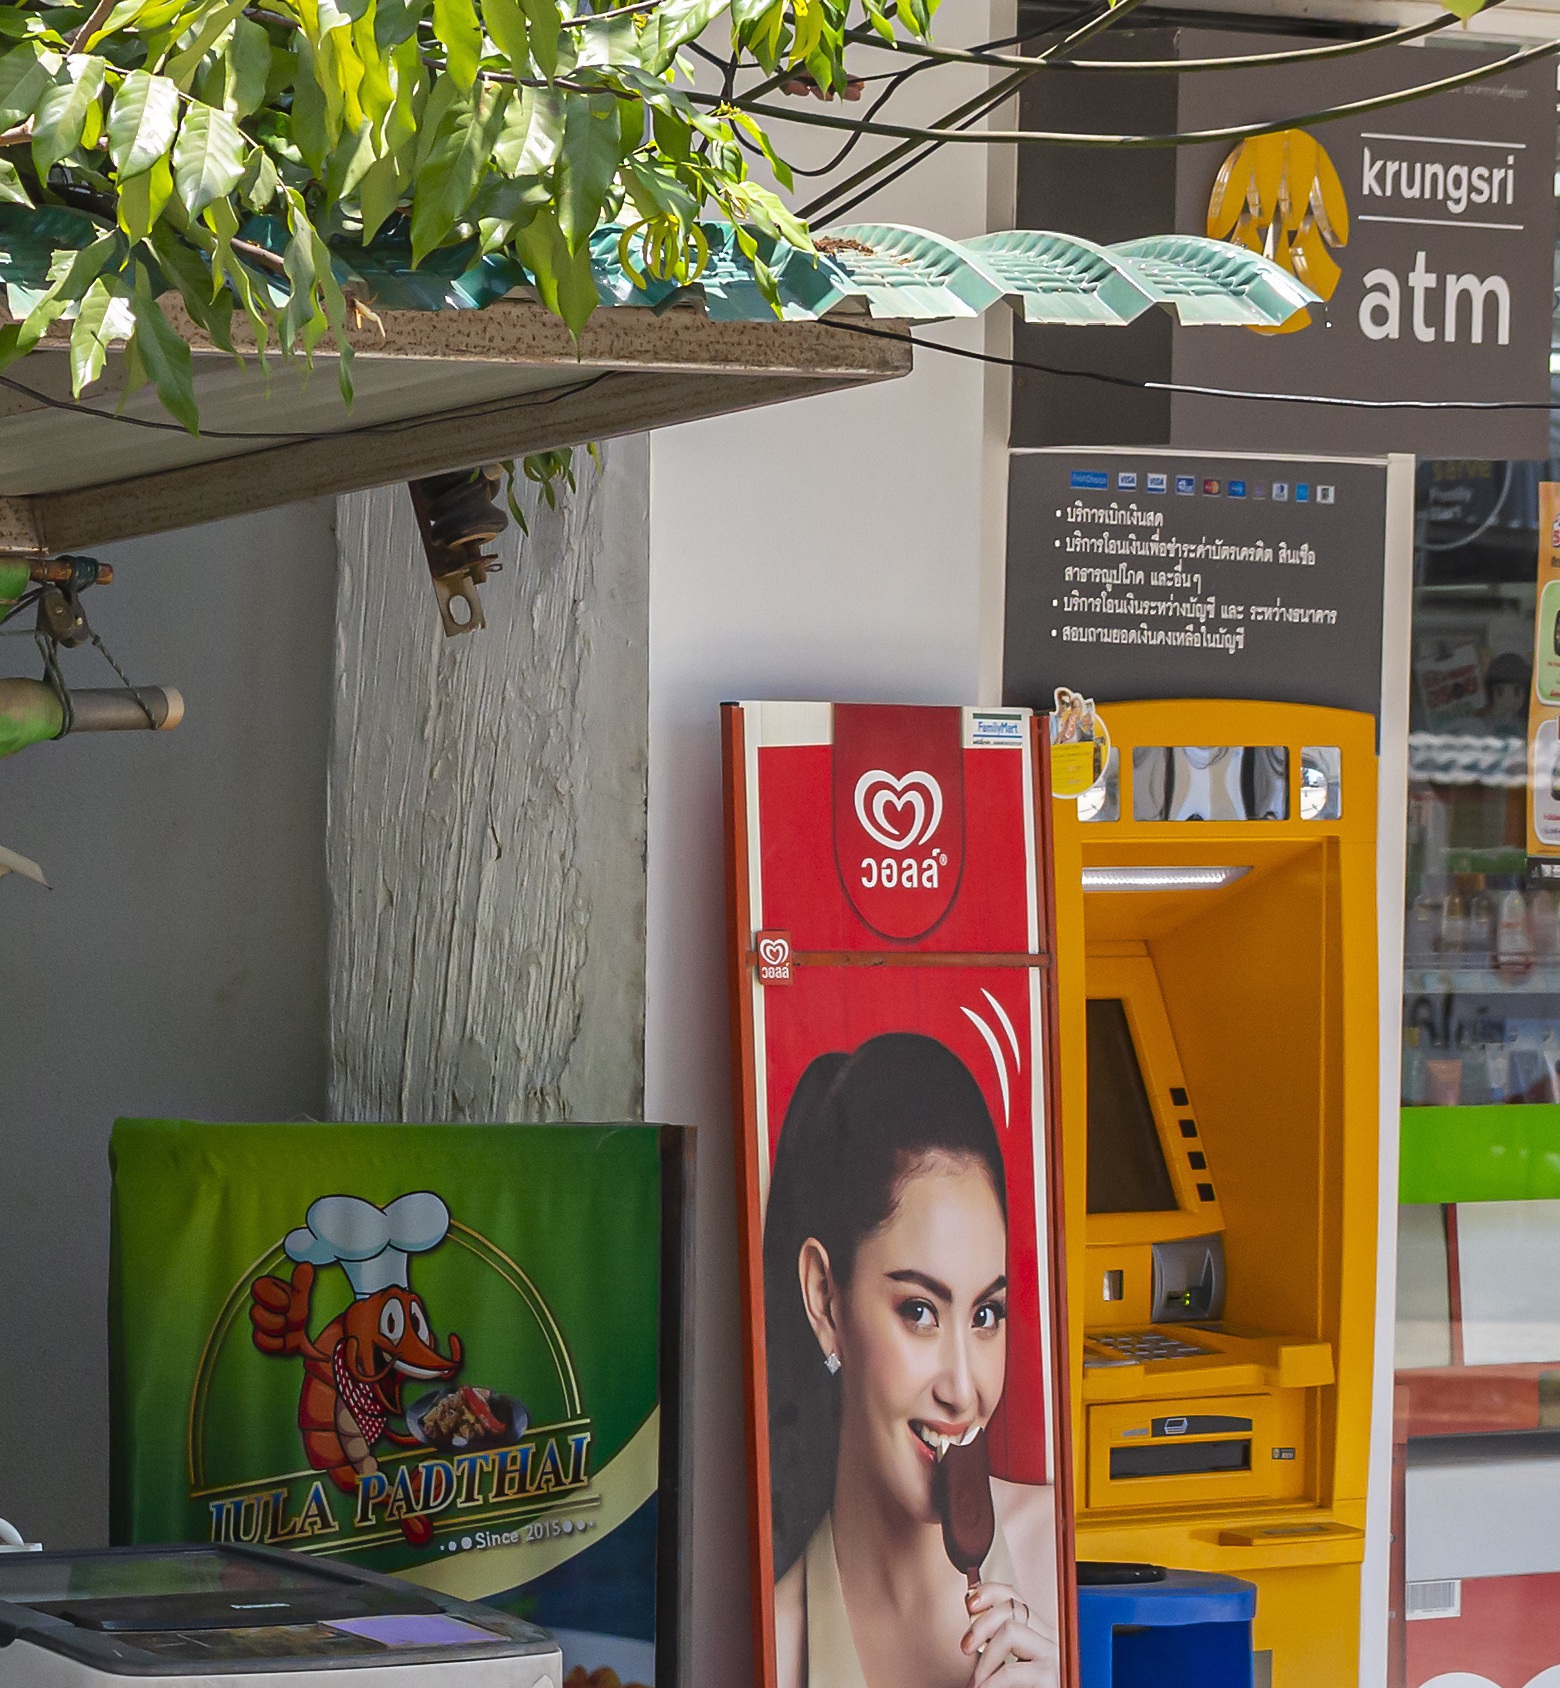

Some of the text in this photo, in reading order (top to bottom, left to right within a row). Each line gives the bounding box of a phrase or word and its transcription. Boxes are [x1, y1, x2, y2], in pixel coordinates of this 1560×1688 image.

[1362, 146, 1515, 214] krungsri
[1358, 250, 1510, 346] atm
[1066, 500, 1164, 527] บริการเบิกเงินสด
[1220, 604, 1244, 620] และ
[861, 848, 940, 889] วอลล์
[354, 1431, 591, 1528] PADTHAI
[475, 1522, 562, 1550] Since 2015
